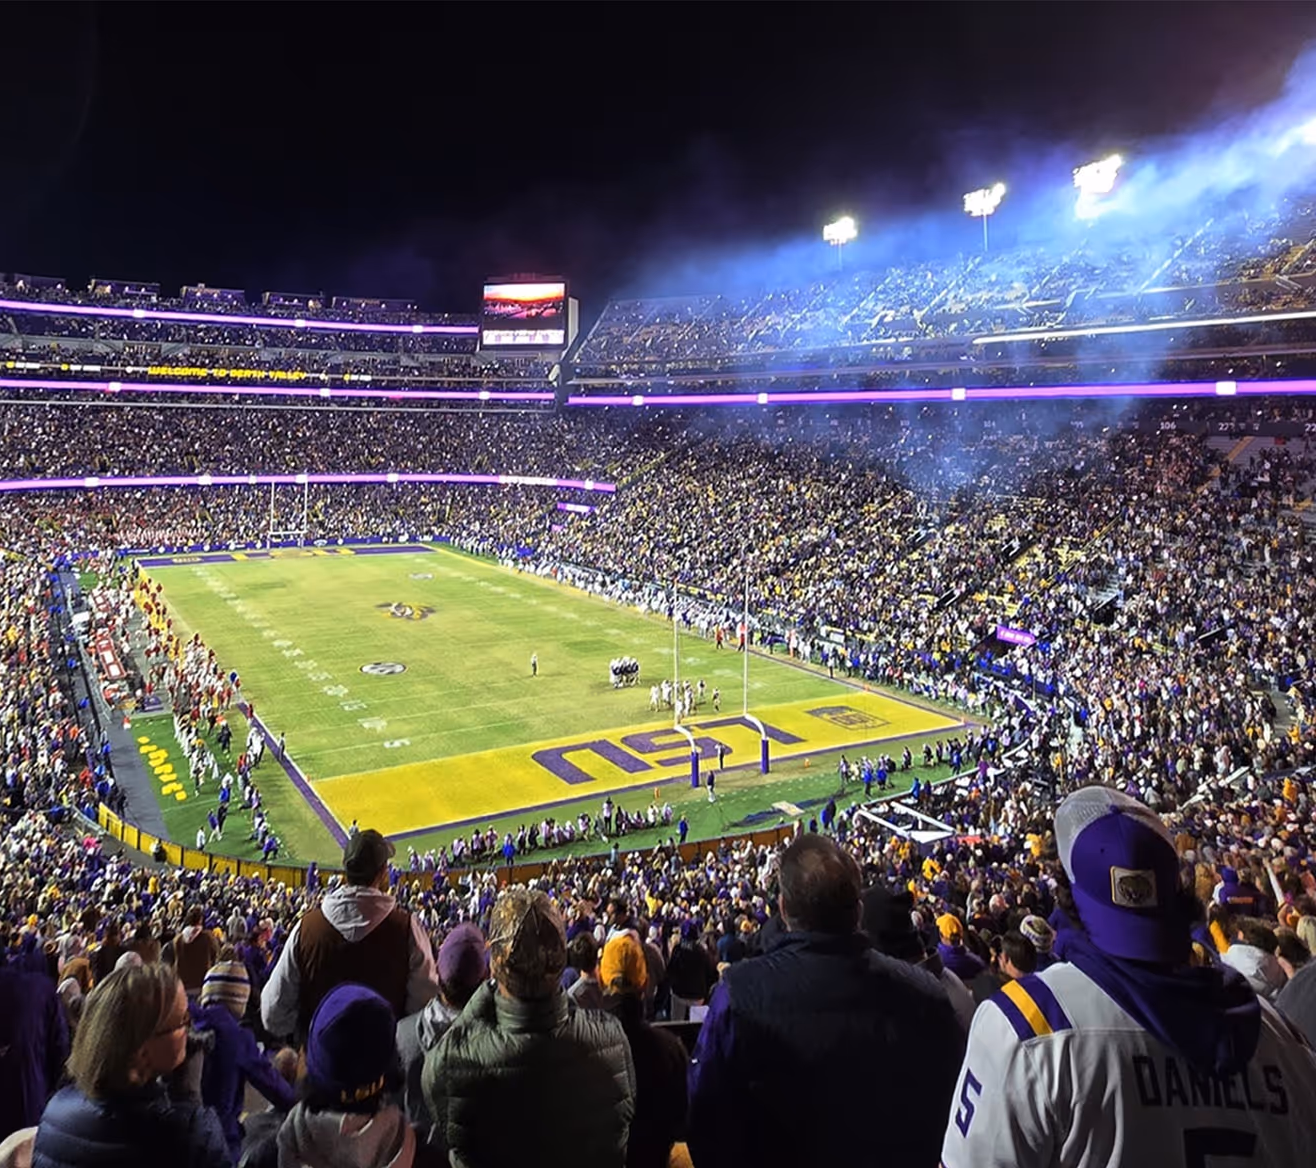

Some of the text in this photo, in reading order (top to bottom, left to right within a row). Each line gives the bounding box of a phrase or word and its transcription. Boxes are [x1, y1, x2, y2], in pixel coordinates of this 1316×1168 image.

[147, 366, 208, 377] WELCOME
[212, 367, 227, 378] TO
[531, 715, 807, 785] LSU
[340, 1073, 386, 1104] LSU
[955, 1067, 983, 1138] 5
[1132, 1055, 1289, 1115] DANIELS
